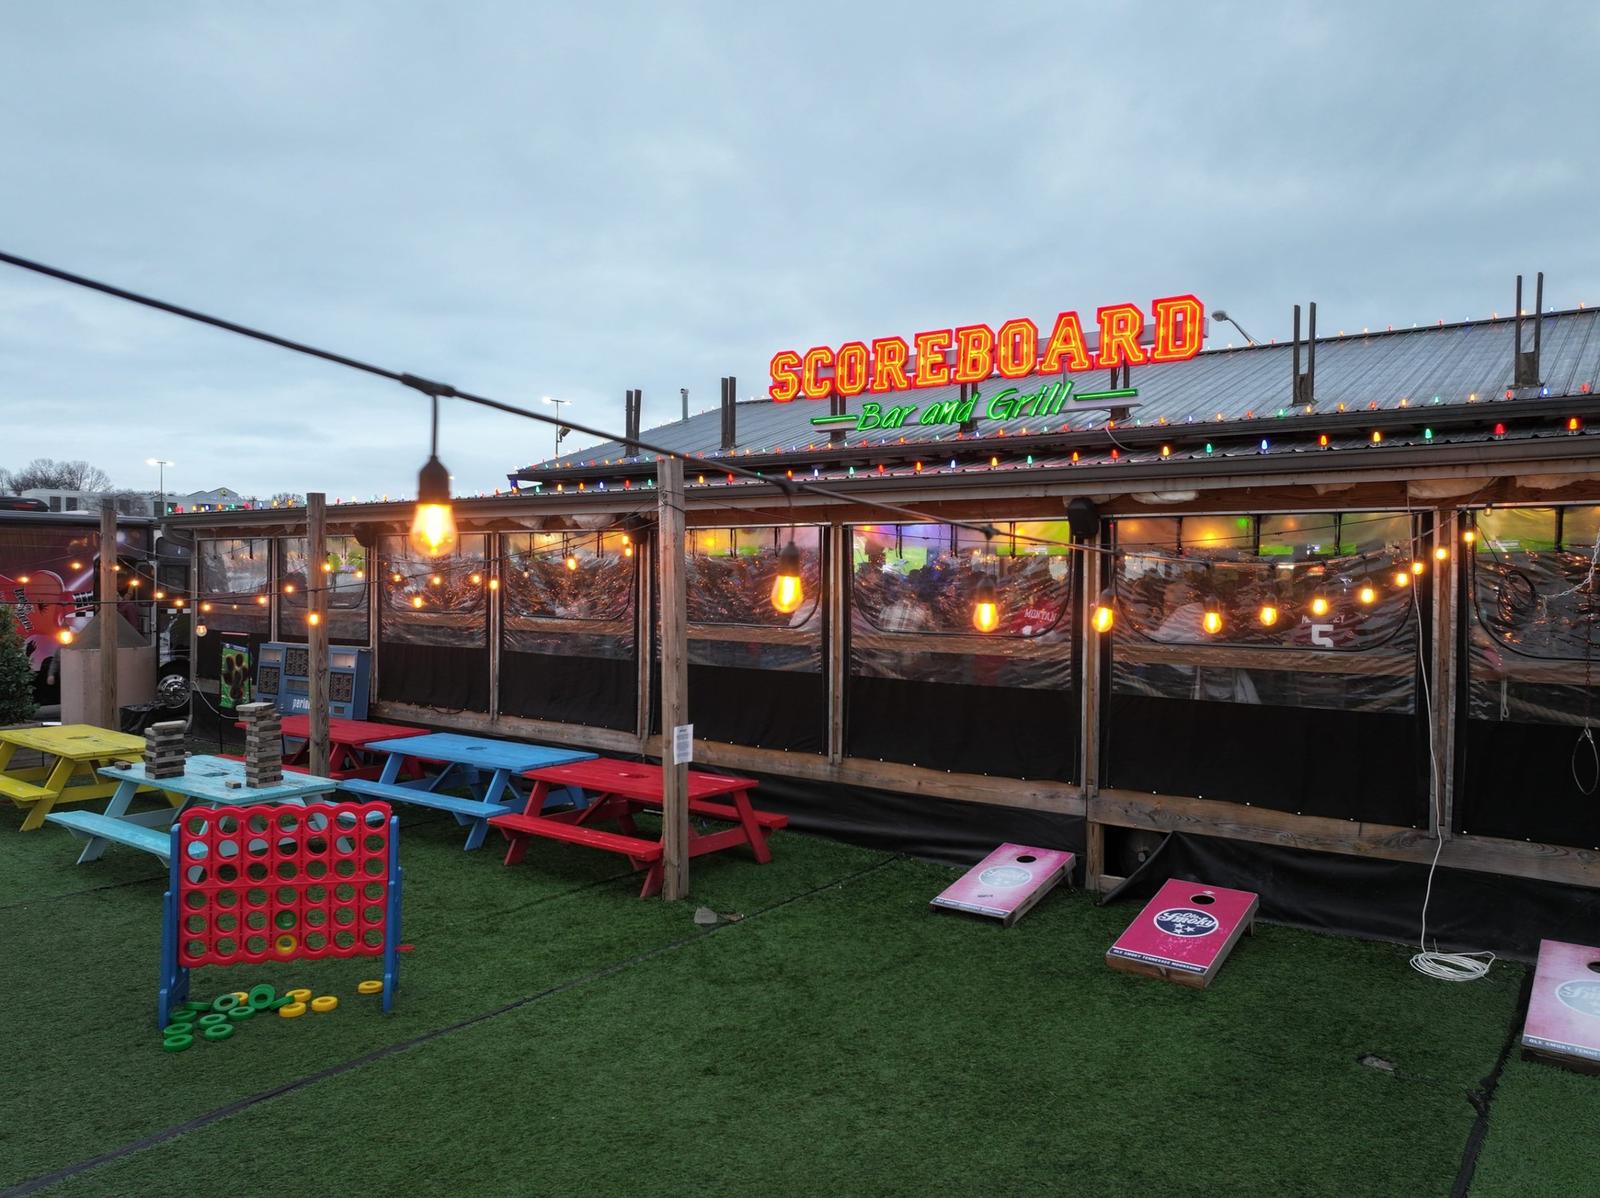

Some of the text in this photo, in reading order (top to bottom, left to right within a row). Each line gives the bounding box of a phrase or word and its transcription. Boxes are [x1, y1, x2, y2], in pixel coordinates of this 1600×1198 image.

[769, 294, 1205, 402] SCOREBOARD
[857, 380, 1075, 431] Bar and Grill
[1312, 624, 1334, 648] 5
